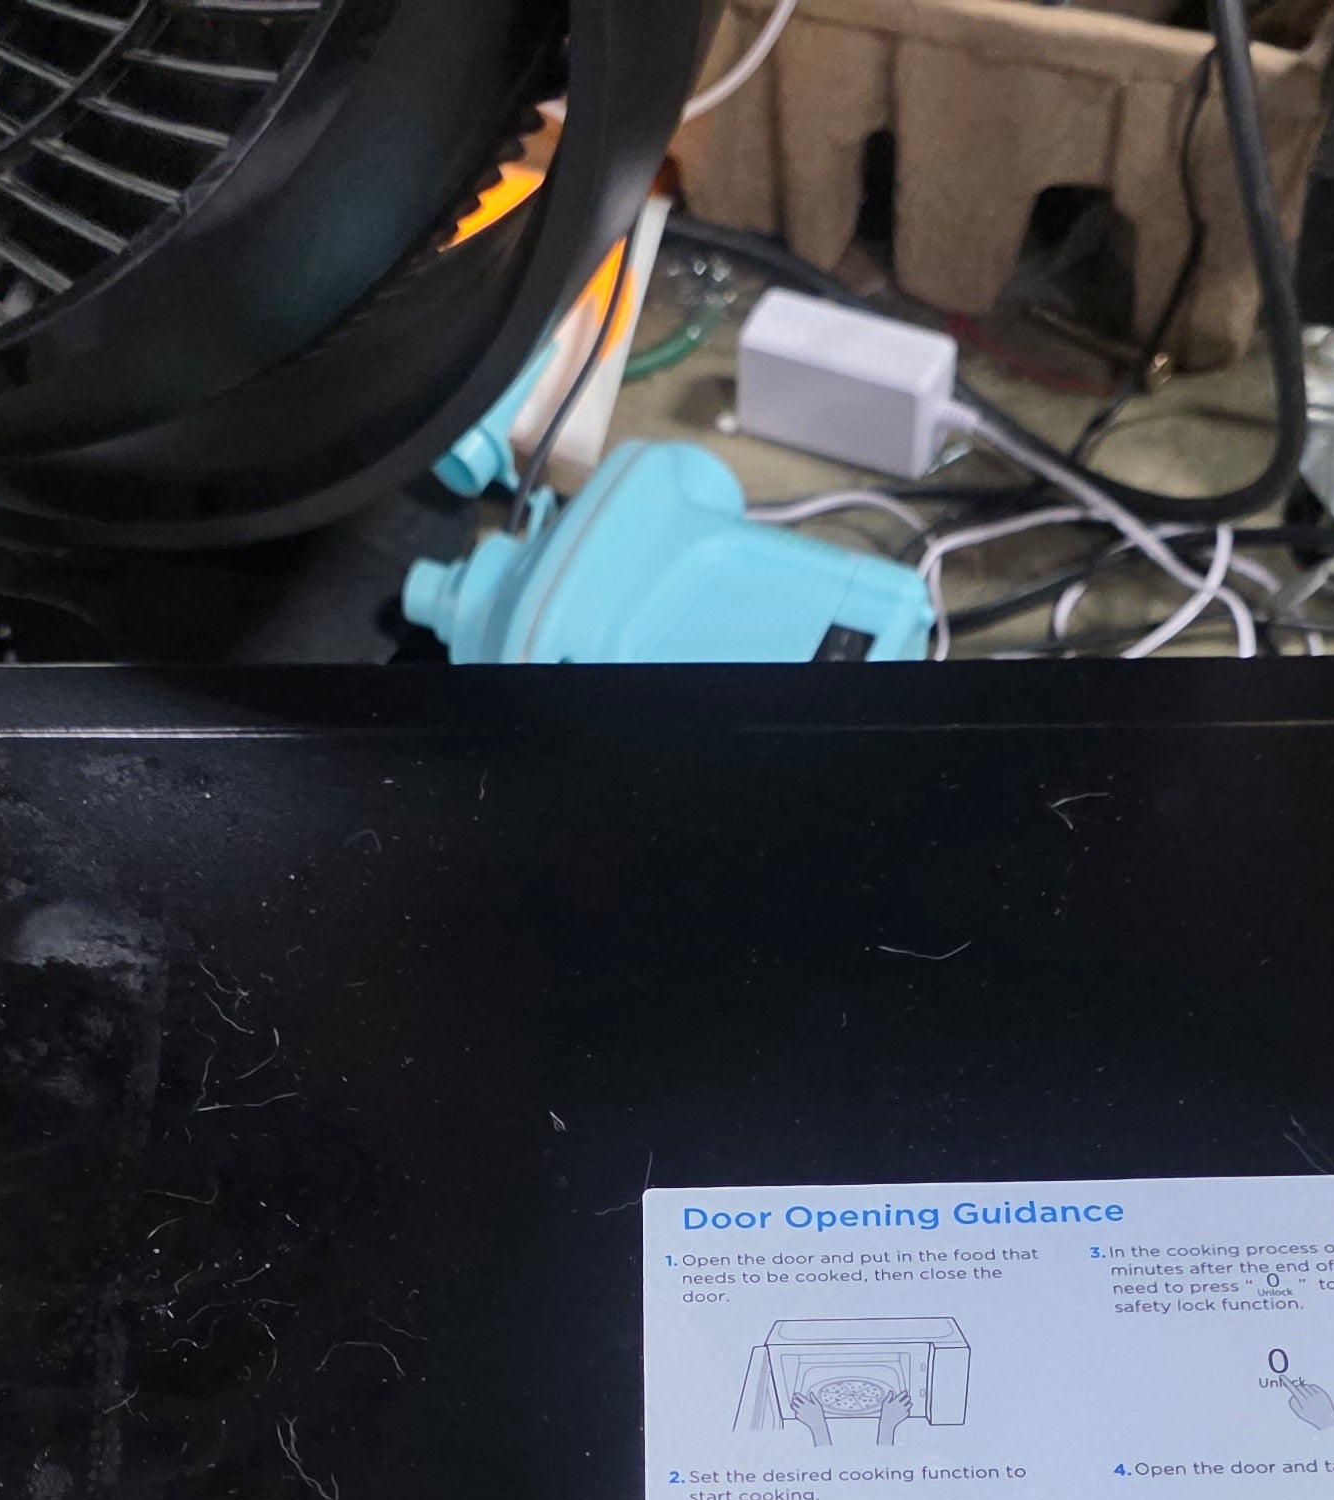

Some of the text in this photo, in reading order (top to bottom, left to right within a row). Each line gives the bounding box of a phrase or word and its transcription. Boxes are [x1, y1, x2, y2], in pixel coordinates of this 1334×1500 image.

[682, 1199, 1124, 1233] Door Opening Guidance
[664, 1247, 1039, 1269] 1. Open the door and put in the food that
[1088, 1245, 1106, 1259] 3.
[1108, 1245, 1125, 1258] In
[1129, 1244, 1160, 1258] the
[1165, 1243, 1240, 1259] cooking
[1245, 1243, 1319, 1258] process
[681, 1265, 1002, 1285] needs to be cooked, then close the
[1110, 1262, 1184, 1276] minutes
[1188, 1260, 1234, 1275] after
[1238, 1260, 1269, 1274] the
[1274, 1258, 1310, 1273] end
[1314, 1258, 1334, 1272] of
[681, 1289, 730, 1303] door.
[1112, 1280, 1158, 1295] need
[1163, 1281, 1184, 1294] to
[1189, 1281, 1240, 1296] press
[1256, 1287, 1293, 1297] Unlock
[1113, 1296, 1304, 1315] safety lock function.
[1257, 1375, 1307, 1389] Unlck
[667, 1464, 1027, 1484] 2. Set the desired cooking function to
[1112, 1462, 1132, 1477] 4.
[1133, 1461, 1187, 1478] Open
[1191, 1460, 1224, 1475] the
[1229, 1459, 1276, 1474] door
[1281, 1458, 1318, 1474] and
